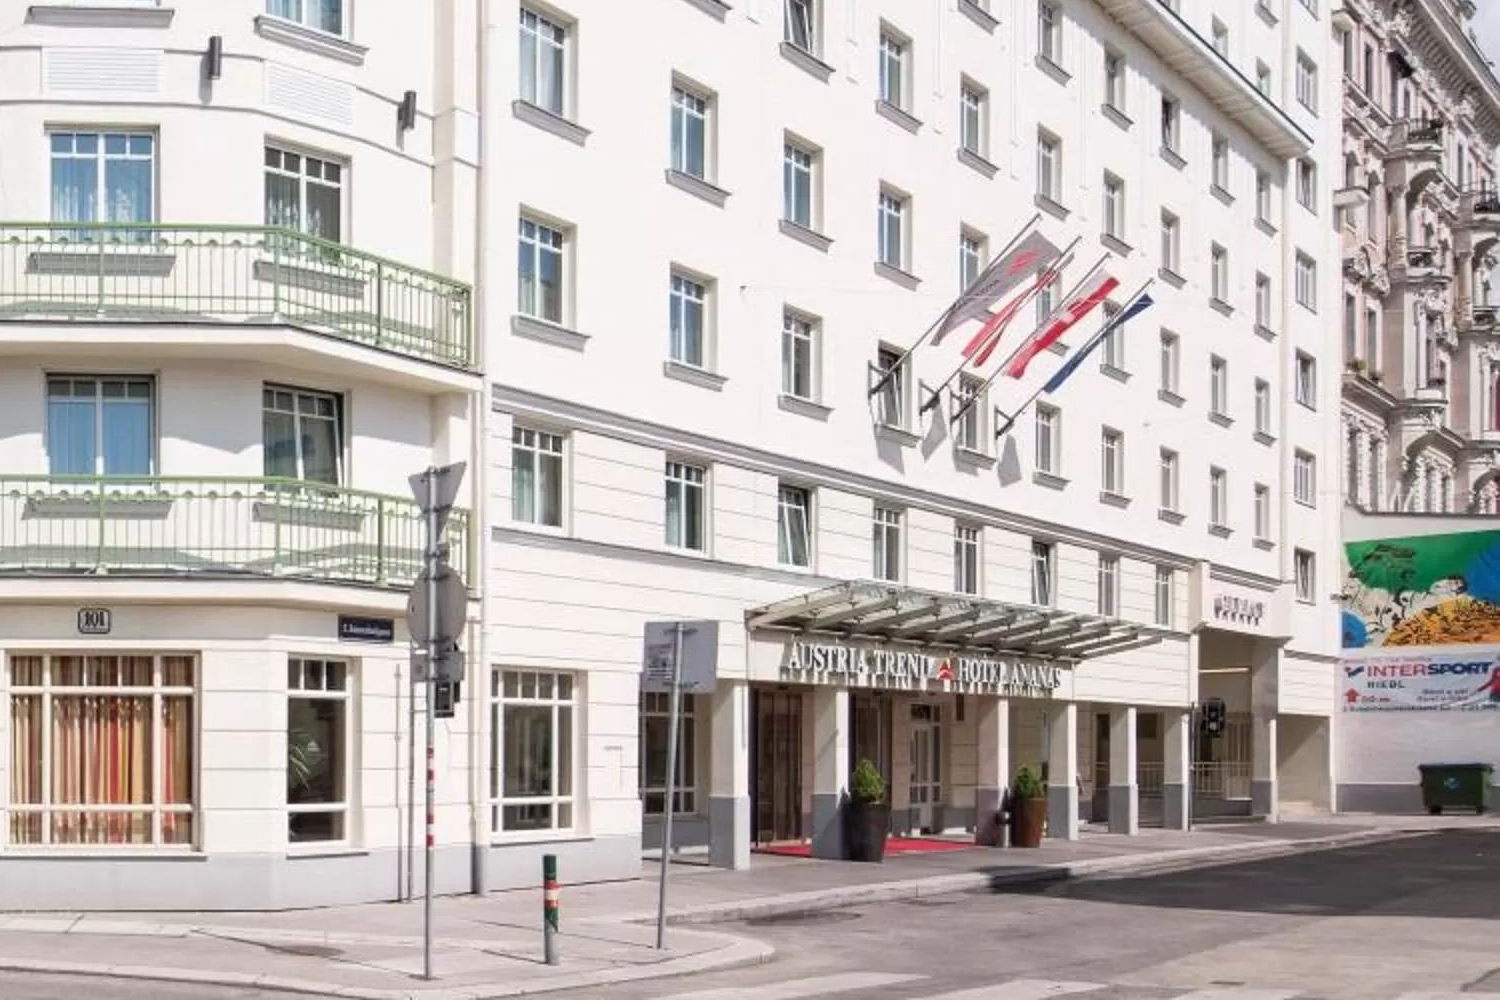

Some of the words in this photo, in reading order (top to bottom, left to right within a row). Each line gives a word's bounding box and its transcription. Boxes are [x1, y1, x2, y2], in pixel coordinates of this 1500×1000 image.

[84, 611, 105, 629] 101
[788, 641, 869, 676] AUSTRIA
[873, 649, 936, 679] TREND
[958, 657, 1008, 686] HOTEL
[1010, 662, 1062, 689] ANANAS
[1366, 661, 1493, 678] INTERSPORT
